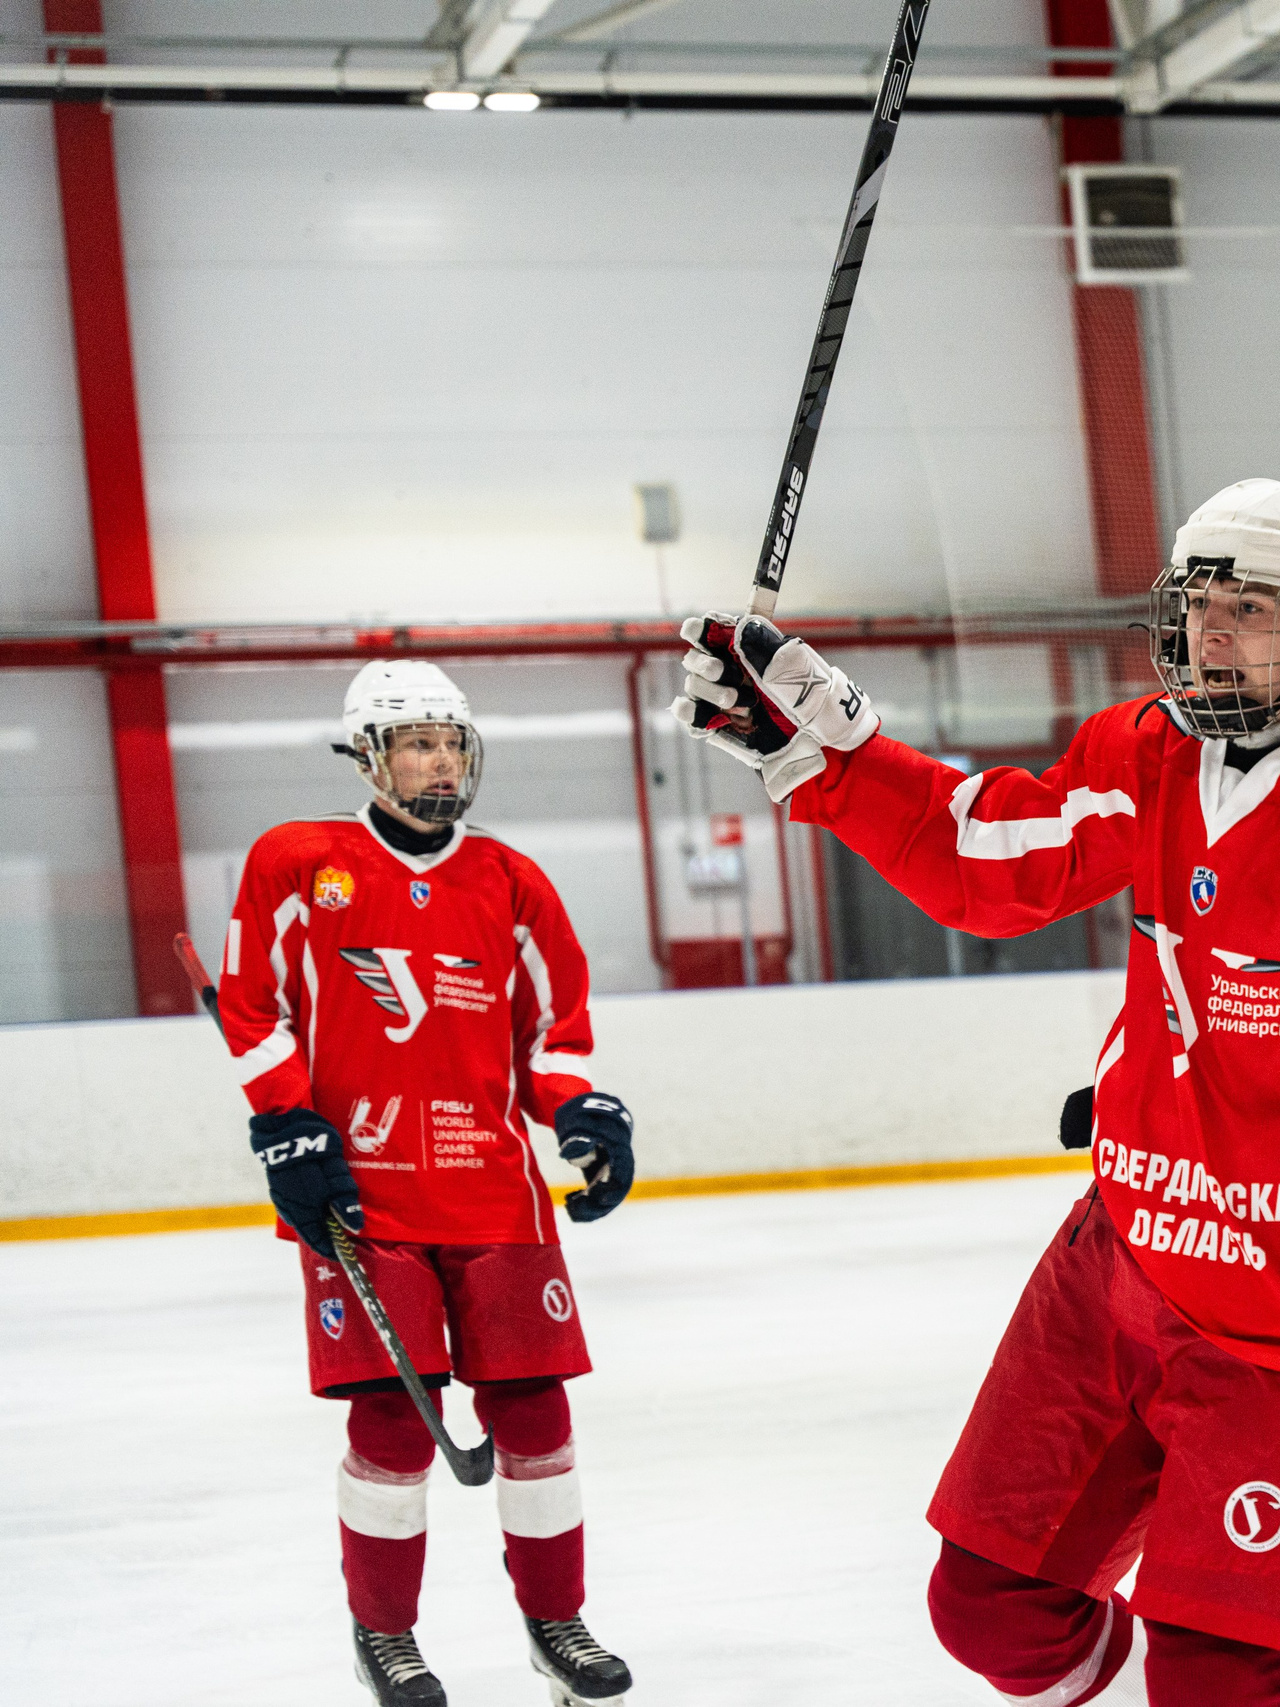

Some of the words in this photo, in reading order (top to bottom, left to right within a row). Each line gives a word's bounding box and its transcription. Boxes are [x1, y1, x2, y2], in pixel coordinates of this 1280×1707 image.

[319, 882, 344, 901] 75
[431, 1099, 474, 1114] FISU
[432, 1115, 475, 1129] WORLD
[433, 1129, 498, 1144] UNIVERSITY
[433, 1143, 476, 1156] GAMES
[434, 1157, 486, 1170] SUMMER
